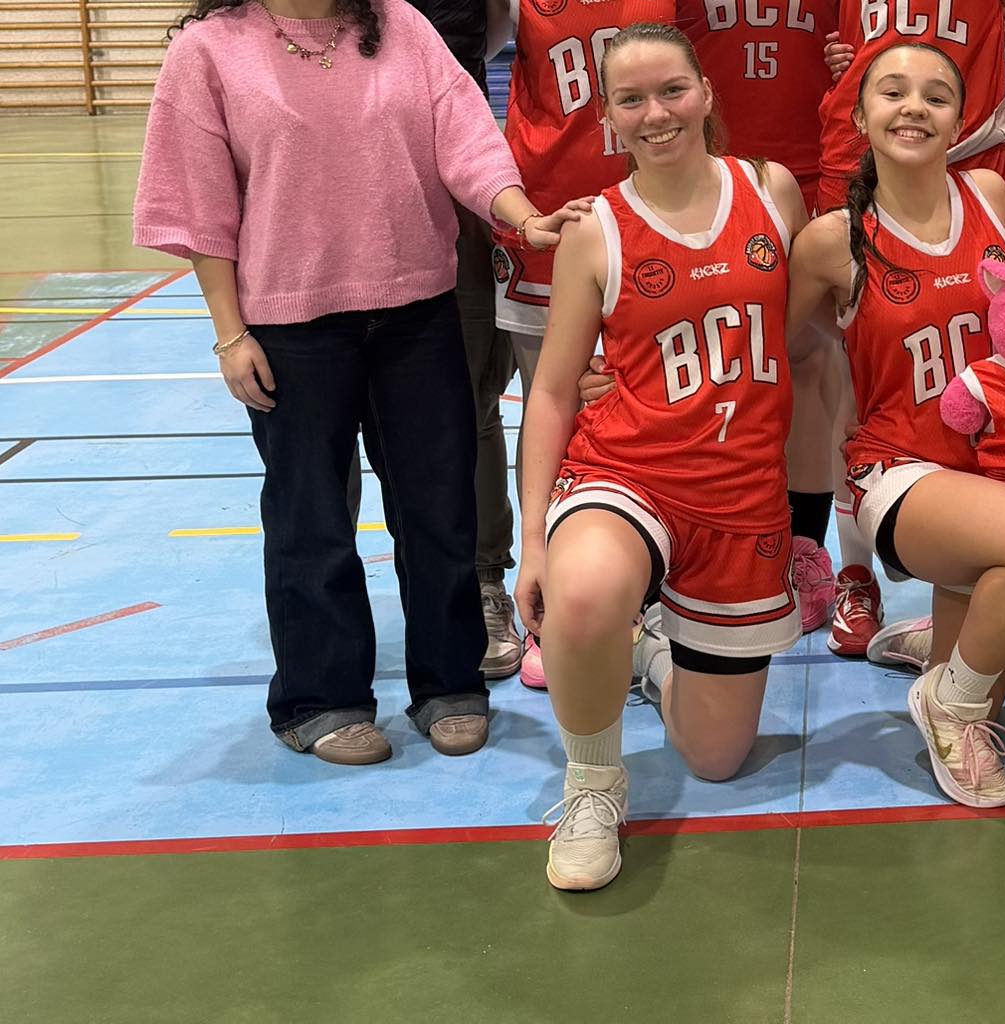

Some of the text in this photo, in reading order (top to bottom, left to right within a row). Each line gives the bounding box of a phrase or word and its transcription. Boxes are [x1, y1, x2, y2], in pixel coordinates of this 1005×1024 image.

[548, 26, 622, 116] BC
[743, 41, 779, 79] 15
[689, 262, 730, 280] KICKZ
[933, 273, 972, 289] KICKZ
[655, 303, 778, 405] BCL
[902, 311, 982, 407] BC
[714, 400, 736, 443] 7
